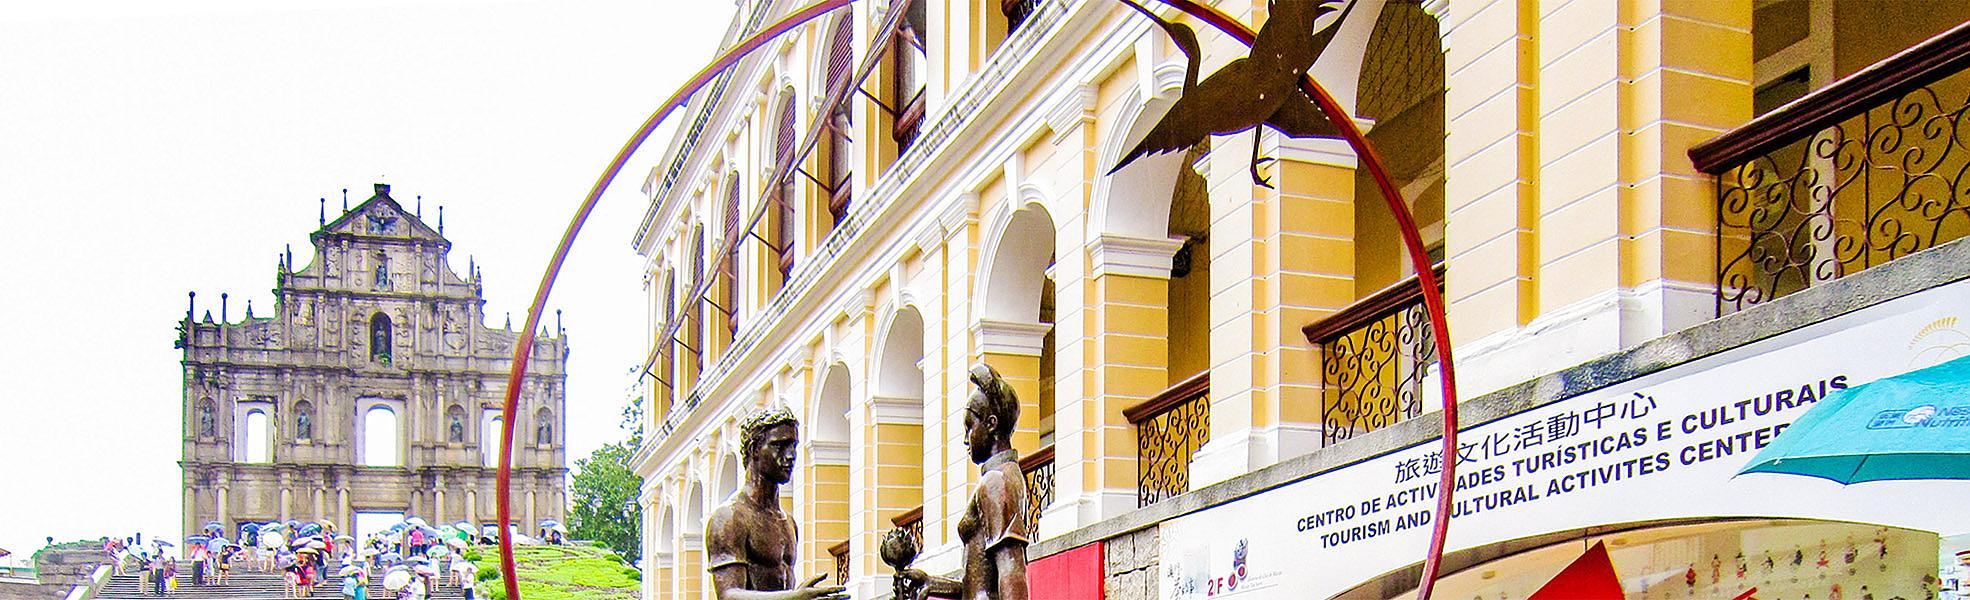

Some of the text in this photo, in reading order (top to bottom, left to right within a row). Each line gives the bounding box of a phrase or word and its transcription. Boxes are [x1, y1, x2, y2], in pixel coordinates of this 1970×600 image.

[1297, 375, 1849, 533] CENTRO DE ACTIVADES TURÍSTICAS E CULTURAIS
[1395, 391, 1657, 484] 旅遊文化活動中心
[1321, 519, 1390, 549] TOURISM
[1395, 509, 1431, 532] AND
[1448, 484, 1540, 519] ULTURAL
[1546, 451, 1671, 498] ACTIVITES
